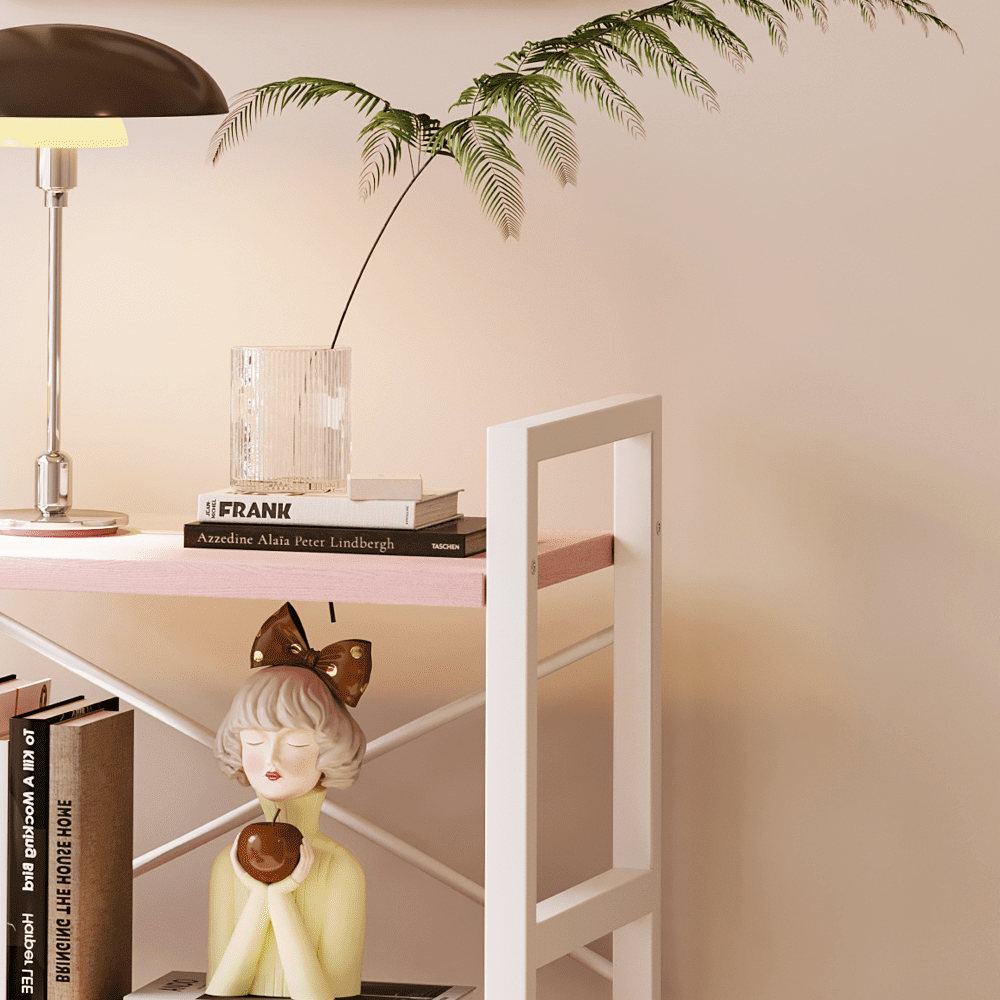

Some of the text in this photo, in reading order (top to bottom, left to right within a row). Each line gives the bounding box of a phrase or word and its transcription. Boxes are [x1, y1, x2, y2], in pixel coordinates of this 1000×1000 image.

[218, 501, 292, 520] FRANK
[197, 531, 394, 553] Azzedine Alaïa Peter Lindbergh
[431, 542, 460, 550] TASCHEN
